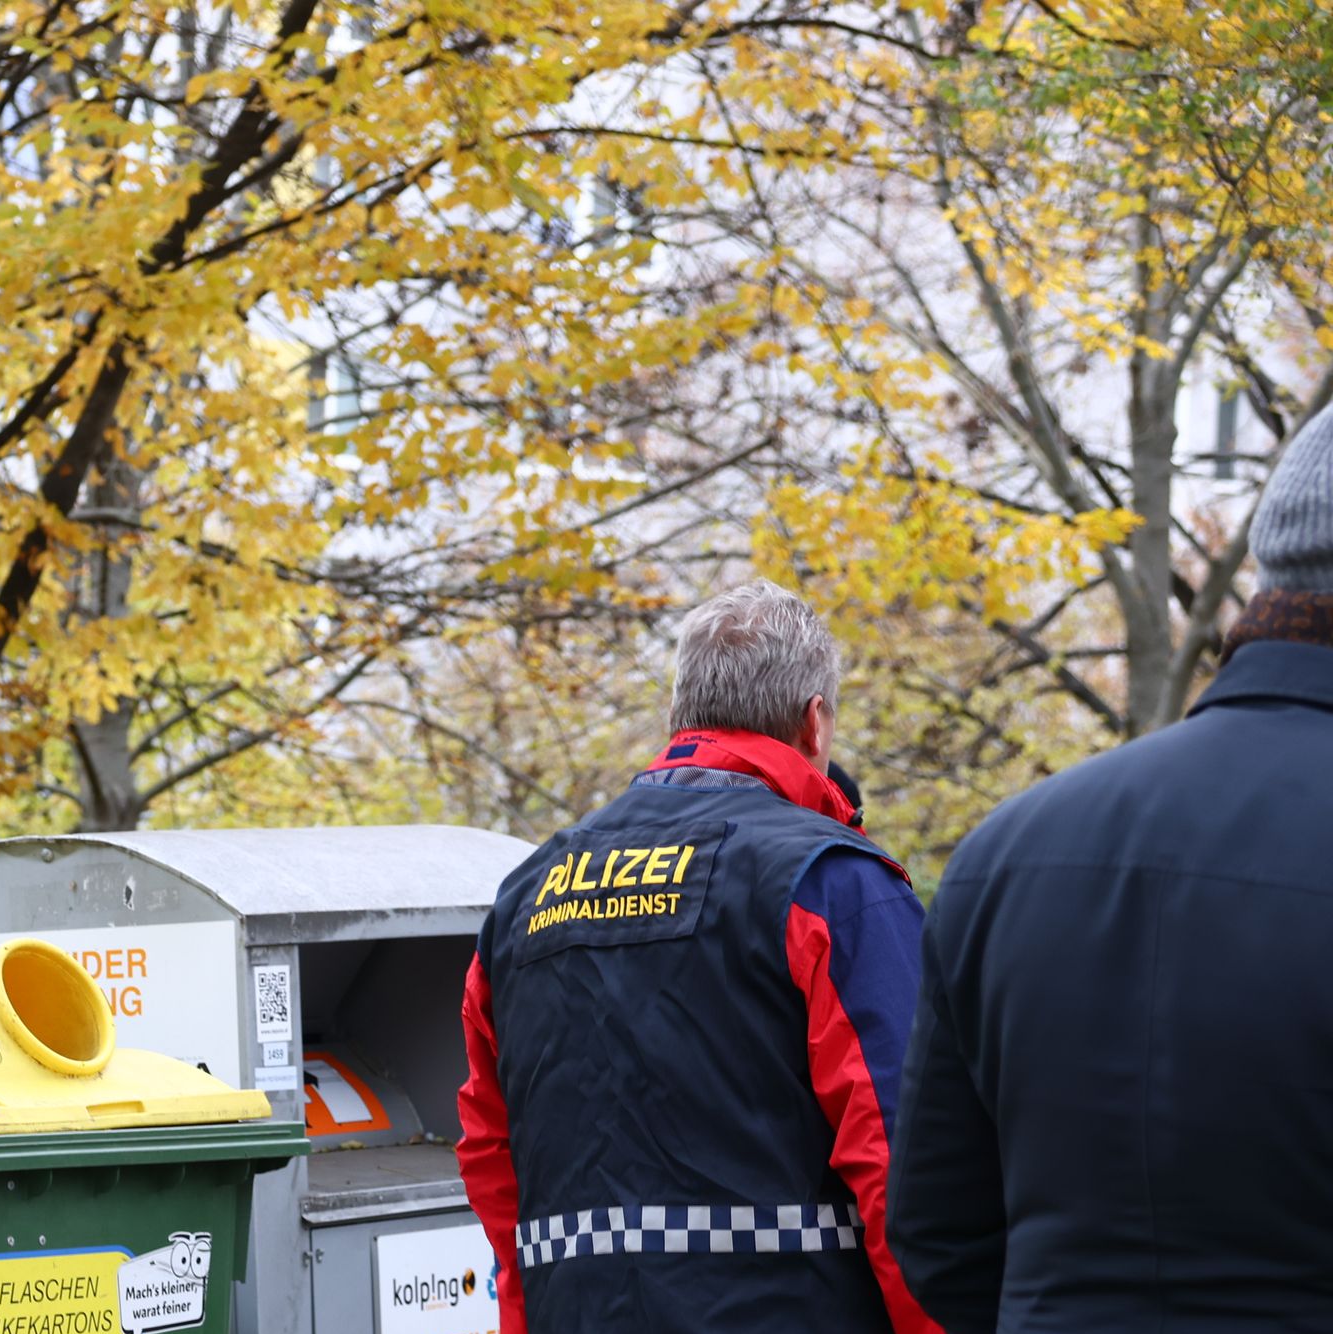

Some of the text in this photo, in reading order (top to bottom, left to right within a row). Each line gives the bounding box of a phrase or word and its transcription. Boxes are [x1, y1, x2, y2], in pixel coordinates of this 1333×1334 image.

[535, 845, 695, 907] POLIZEI
[527, 893, 681, 936] KRIMINALDIENST
[76, 948, 147, 979] DER
[126, 1280, 197, 1300] Mach's kleiner,
[133, 1301, 191, 1320] warat feiner
